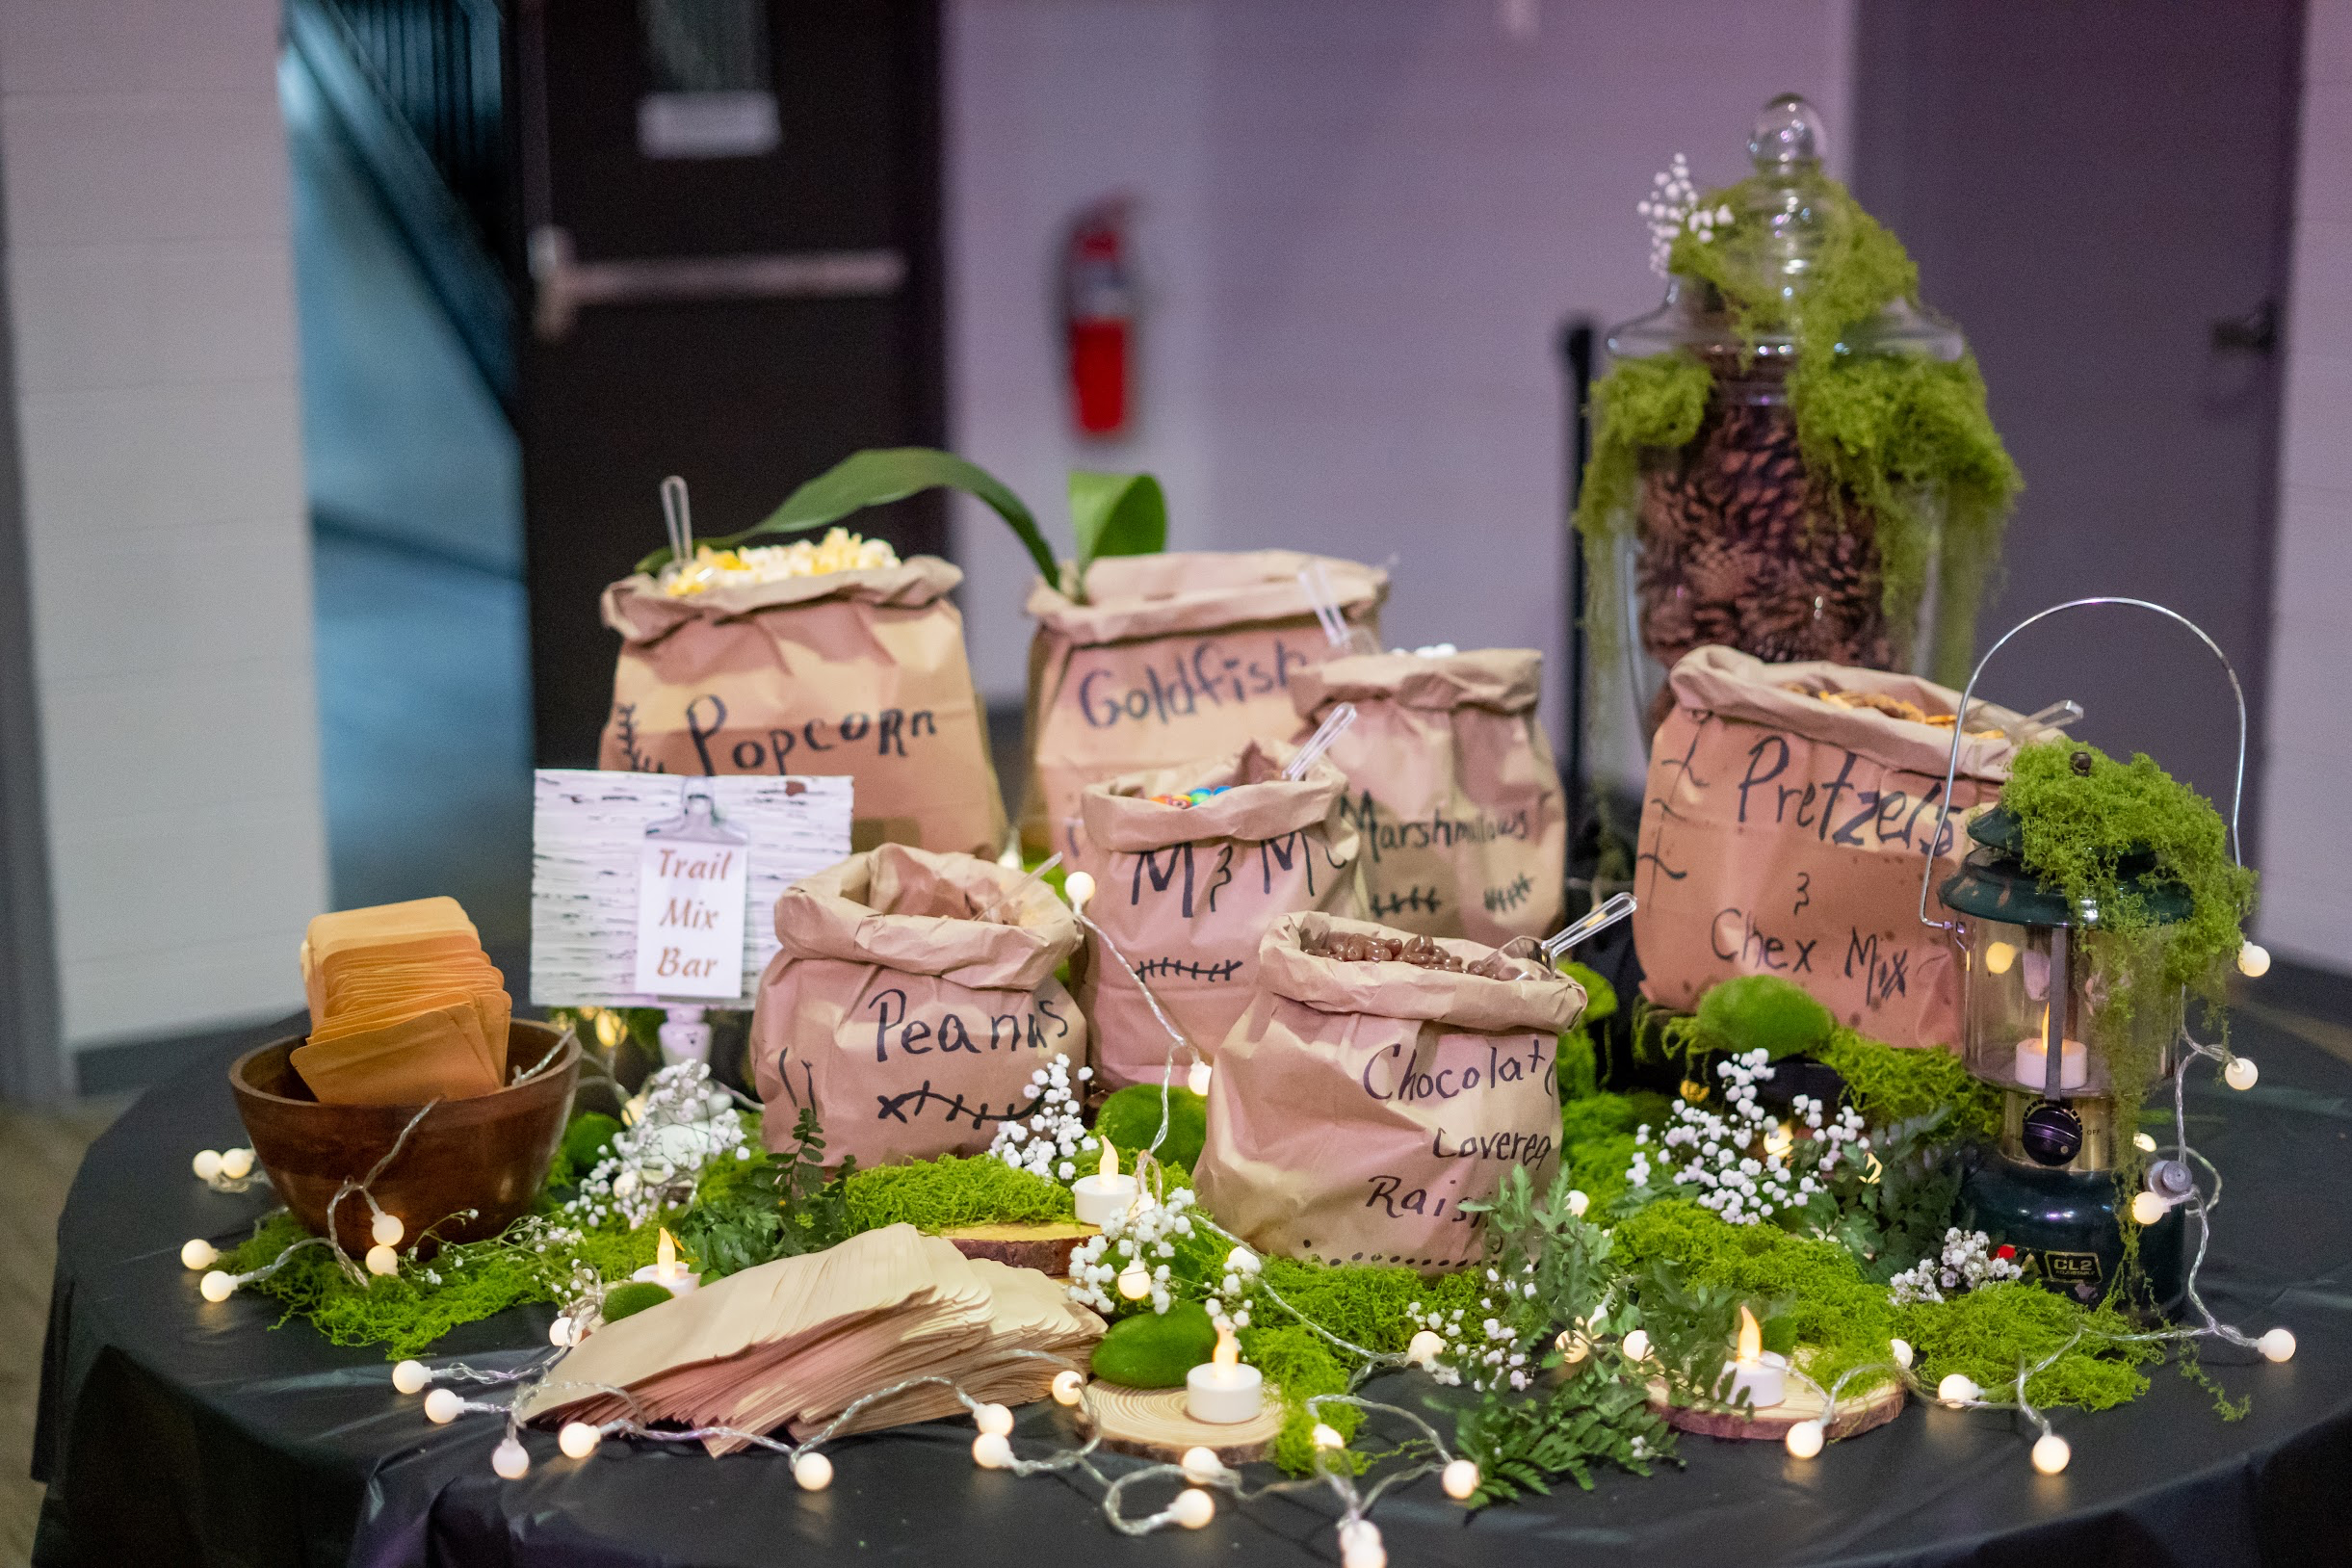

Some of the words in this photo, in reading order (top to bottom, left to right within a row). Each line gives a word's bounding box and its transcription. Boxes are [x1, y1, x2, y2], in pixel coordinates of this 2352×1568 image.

[1078, 638, 1307, 729] Goldfish
[1738, 735, 1962, 857] Pretzels
[658, 849, 733, 881] Trail
[1131, 841, 1194, 918] M
[658, 901, 719, 930] Mix
[657, 947, 719, 978] Bar
[1711, 908, 1817, 973] Chex
[1844, 927, 1910, 1006] Mix
[2053, 1259, 2093, 1271] CL2
